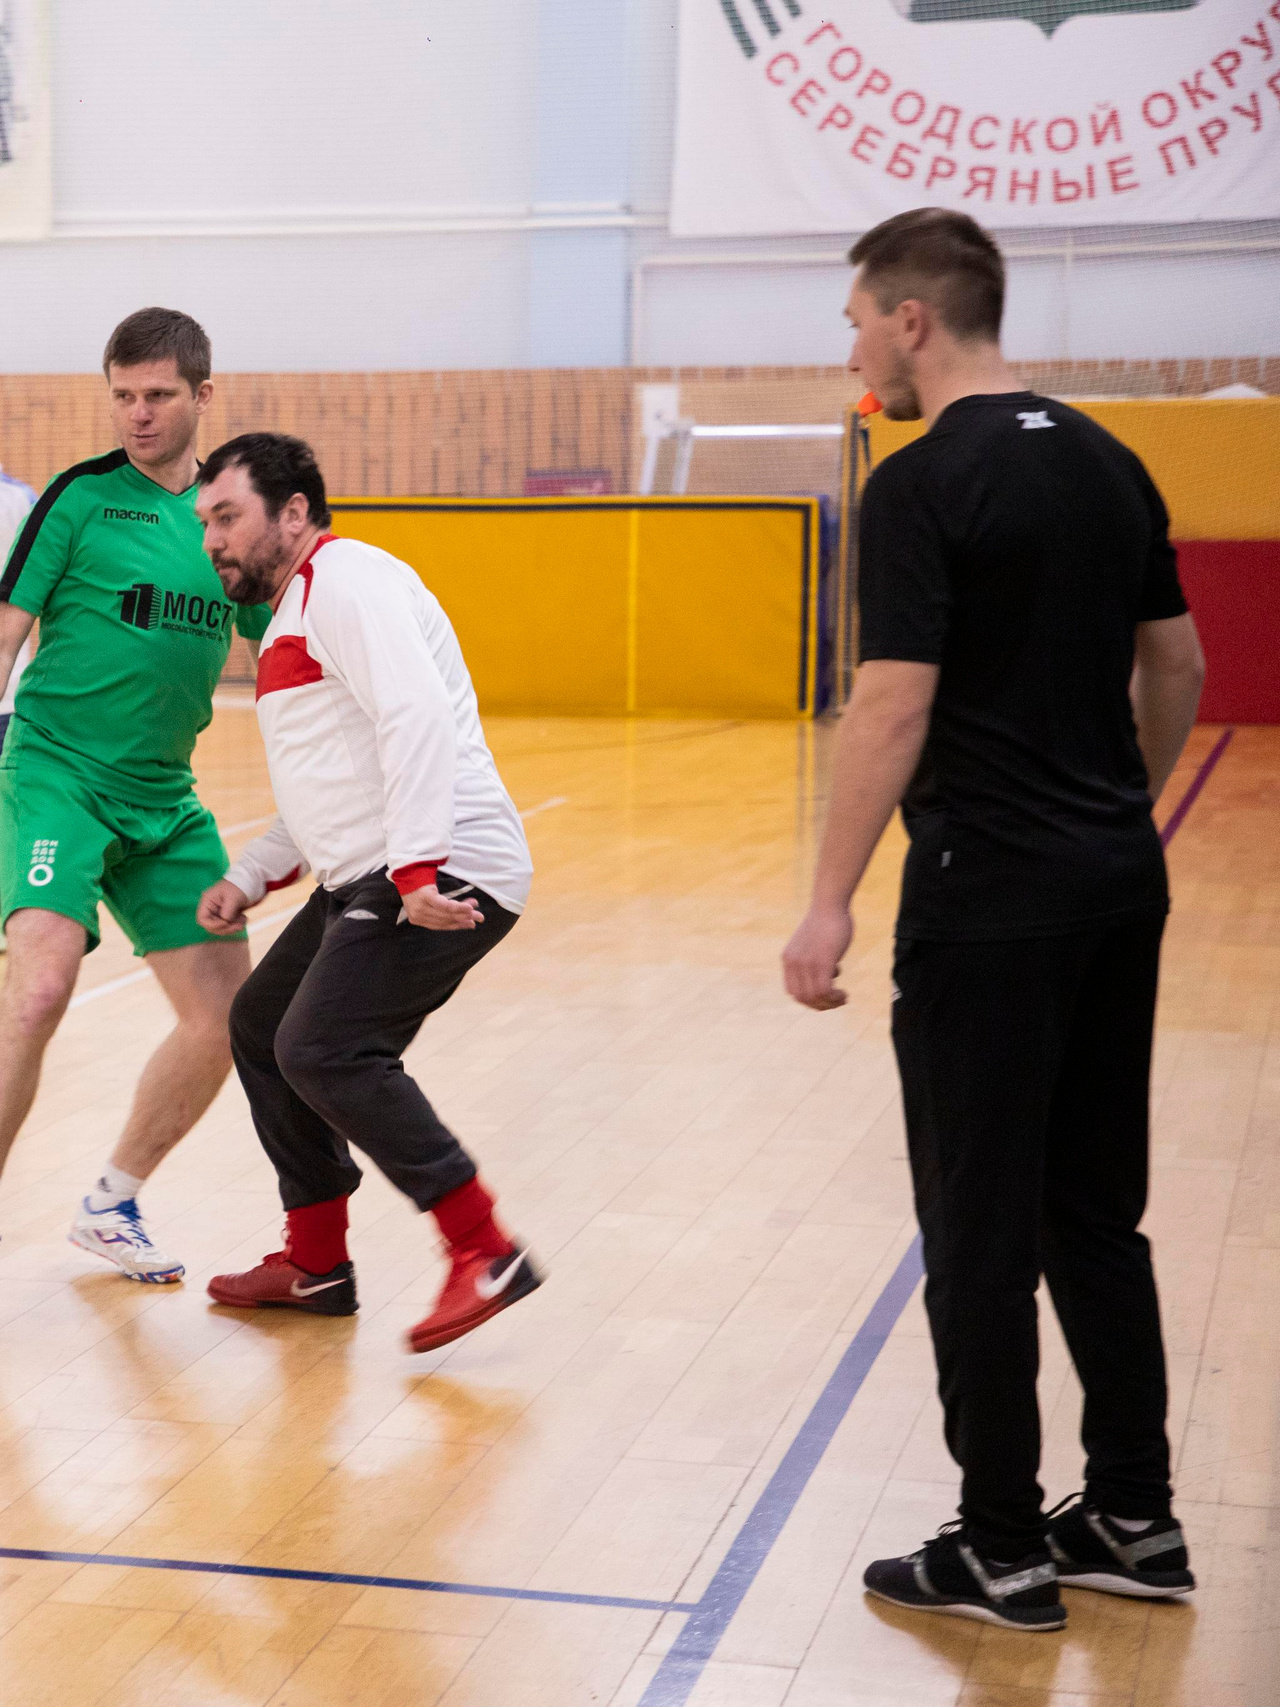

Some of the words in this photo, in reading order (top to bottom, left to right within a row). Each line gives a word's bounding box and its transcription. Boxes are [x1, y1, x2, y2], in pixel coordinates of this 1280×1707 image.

[765, 50, 1141, 204] СЕРЕБРЯНЫЕ
[805, 20, 1123, 154] ГОРОДСКОЙ
[103, 507, 160, 525] macron
[163, 591, 233, 631] МОСТ
